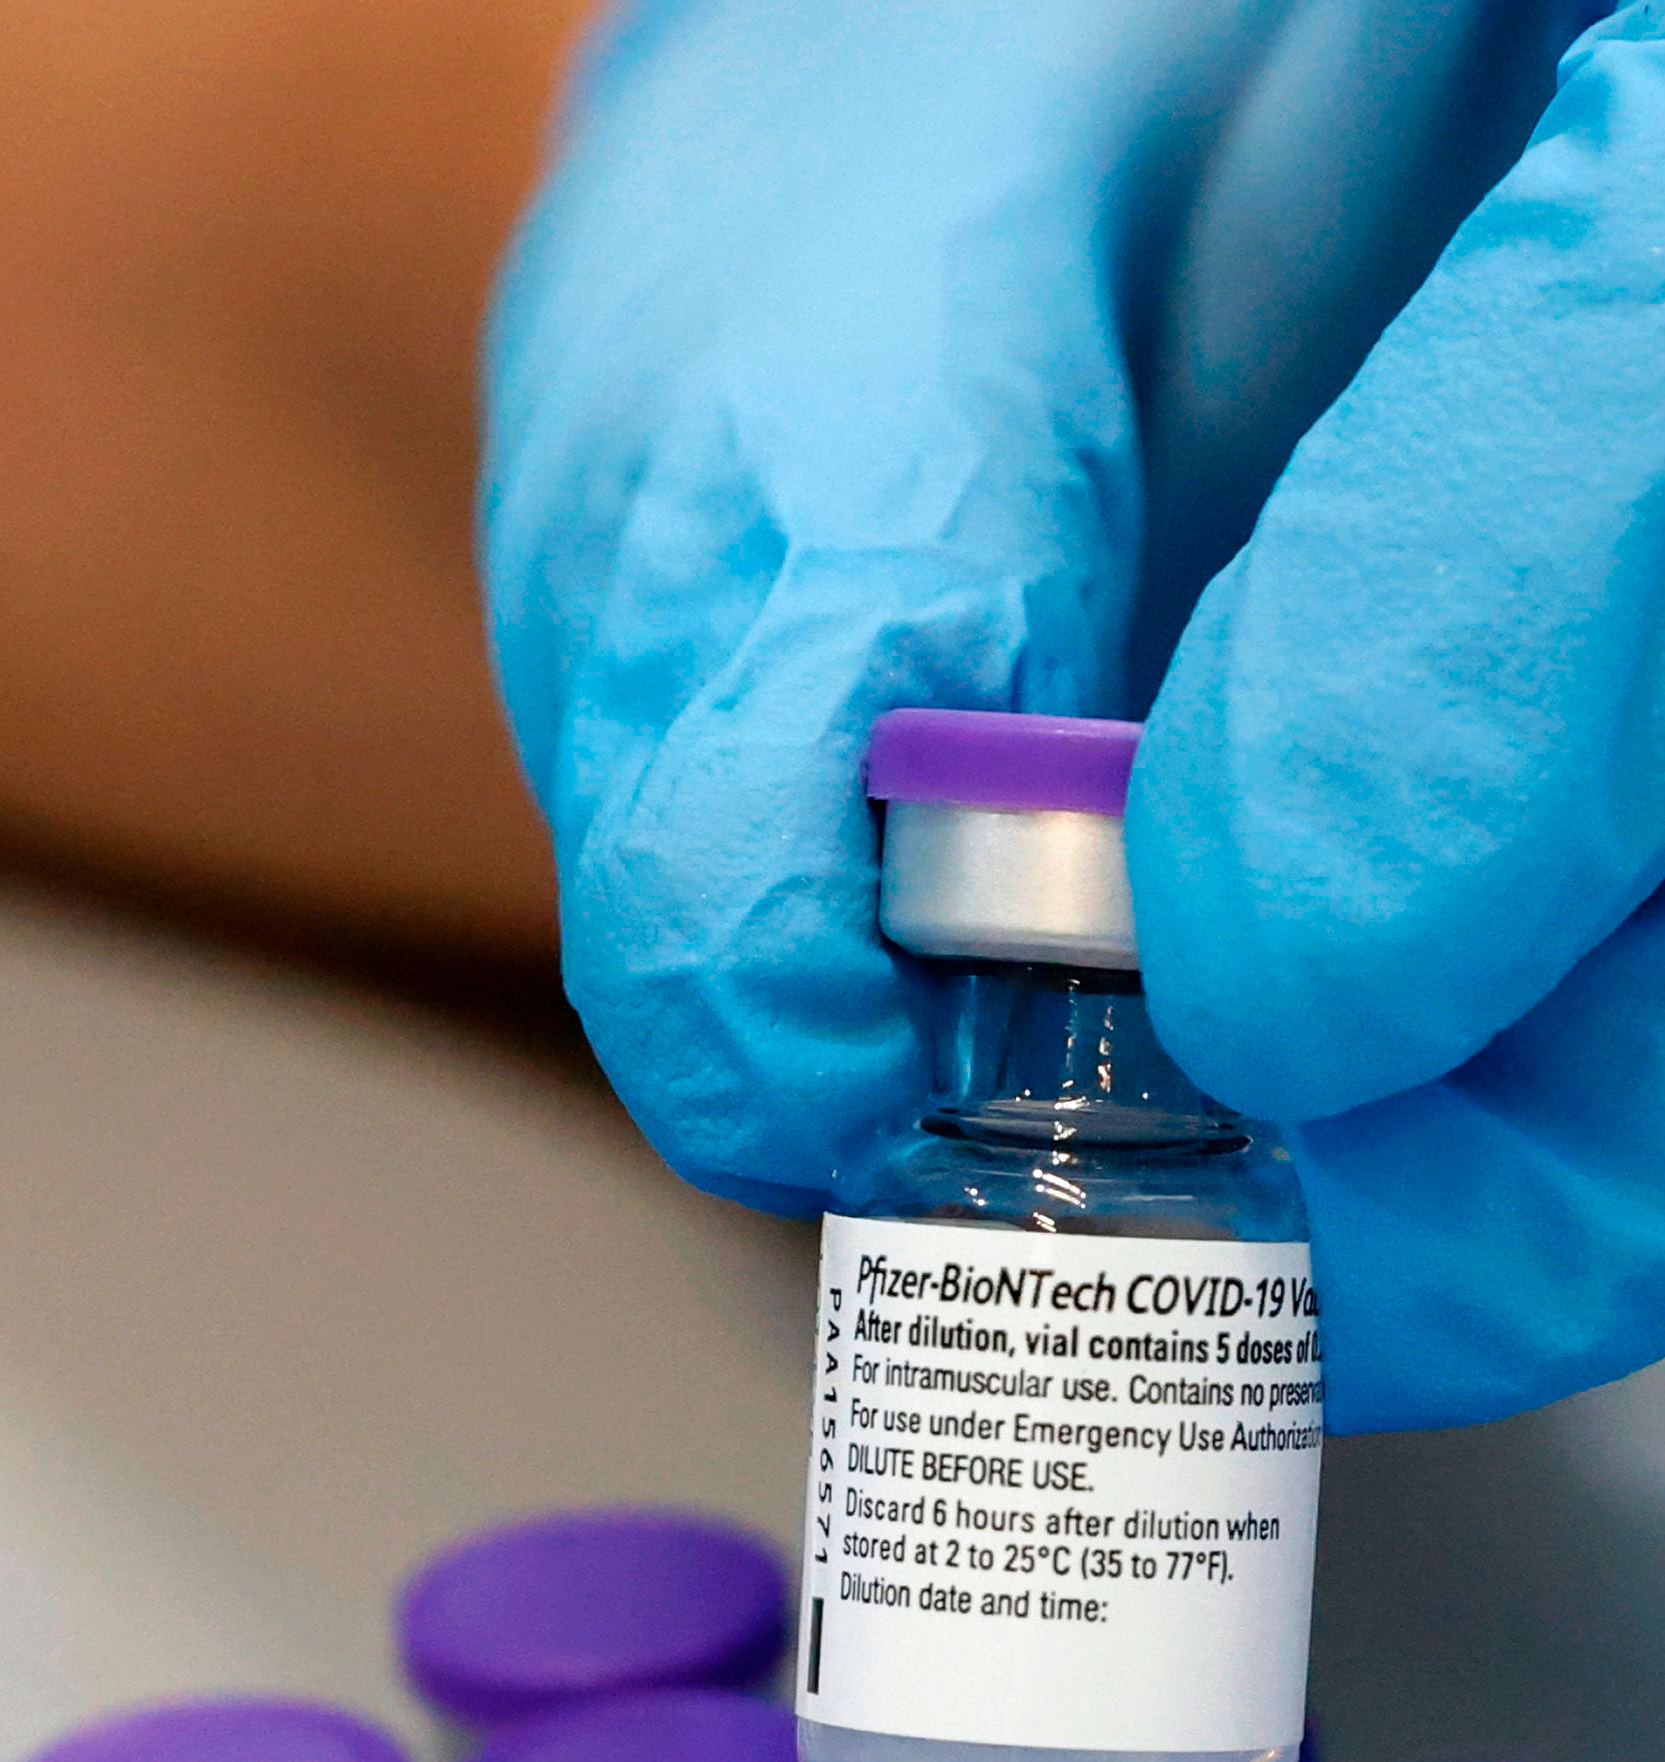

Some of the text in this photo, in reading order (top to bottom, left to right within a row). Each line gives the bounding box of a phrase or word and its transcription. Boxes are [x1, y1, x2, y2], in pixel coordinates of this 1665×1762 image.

[857, 1254, 1319, 1319] Pfizer-BioNTech COVID-19 Va
[854, 1311, 902, 1344] After
[908, 1314, 1016, 1358] dilution,
[1025, 1323, 1079, 1358] vial
[1088, 1329, 1209, 1364] contains
[1216, 1331, 1230, 1364] 5
[1236, 1331, 1292, 1365] doses
[1297, 1330, 1311, 1364] of
[853, 1353, 880, 1384] For
[885, 1361, 1052, 1398] intramuscular
[1062, 1376, 1119, 1403] use.
[1129, 1374, 1234, 1406] Contains
[1241, 1383, 1264, 1407] no
[814, 1287, 842, 1565] PAA156571
[851, 1398, 879, 1429] For
[884, 1410, 921, 1434] use
[929, 1410, 1006, 1440] under
[1013, 1413, 1172, 1457] Emergency
[1179, 1421, 1225, 1451] Use
[848, 1442, 1094, 1492] DILUTE BEFORE USE.
[846, 1487, 1279, 1541] Discard 6 hours after dilution when
[843, 1532, 1233, 1584] stored at 2 to 25°C (35 to 77°F).
[840, 1571, 1108, 1622] Dilution date and time:
